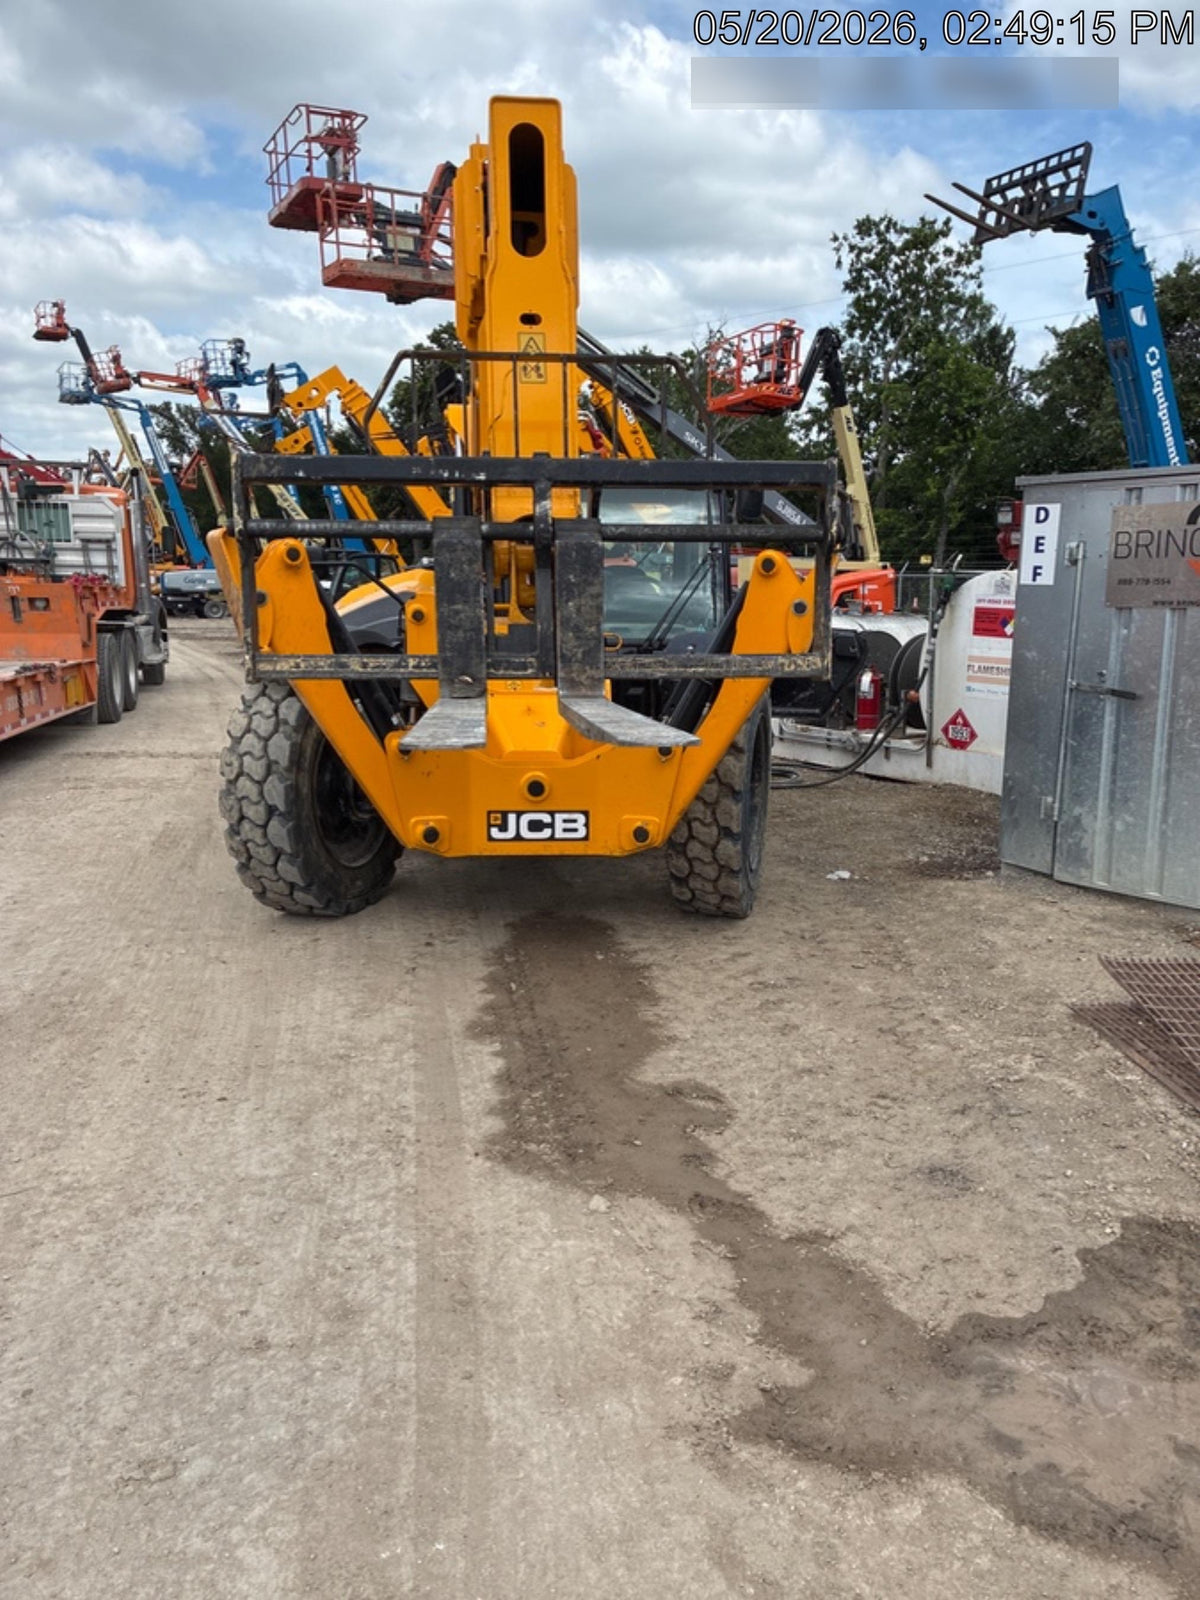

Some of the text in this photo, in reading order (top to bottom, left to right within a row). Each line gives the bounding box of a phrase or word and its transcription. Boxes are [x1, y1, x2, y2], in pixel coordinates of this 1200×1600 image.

[1150, 366, 1182, 467] Equipment
[1031, 506, 1050, 583] DEF
[489, 812, 587, 839] JCB
